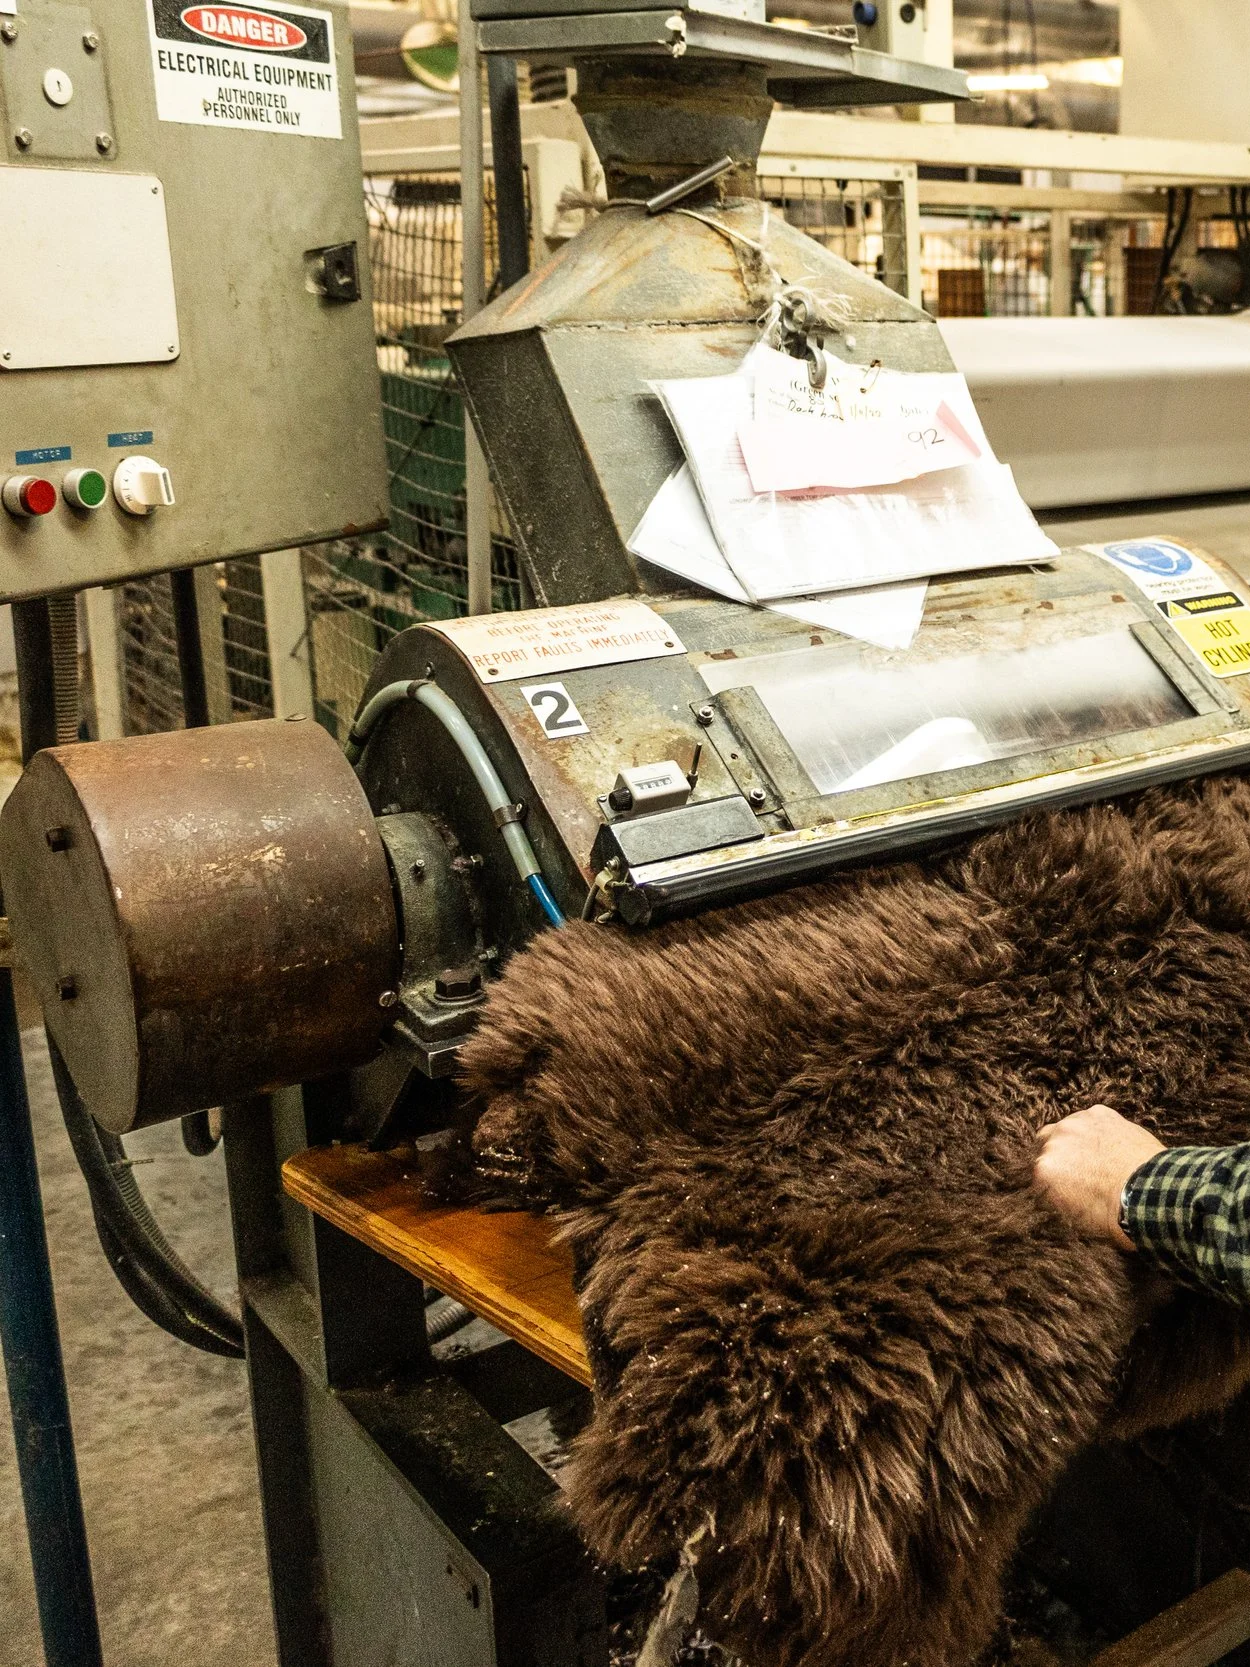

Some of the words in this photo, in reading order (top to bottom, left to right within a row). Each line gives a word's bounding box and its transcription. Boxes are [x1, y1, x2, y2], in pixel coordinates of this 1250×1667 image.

[201, 10, 289, 45] DANGER
[158, 50, 249, 80] ELECTRICAL
[254, 64, 332, 92] EQUIPMENT
[218, 87, 287, 109] AUTHORIZED
[203, 102, 272, 124] PERSONNEL
[276, 110, 300, 126] ONLY
[908, 428, 945, 449] 92
[1184, 595, 1237, 611] WARNING
[487, 623, 540, 637] BEFORE
[547, 613, 620, 629] OPERATING
[1204, 619, 1240, 639] HOT
[473, 649, 530, 668] REPORT
[535, 641, 583, 658] FAULTS
[587, 628, 670, 650] IMMEDIATELY
[531, 690, 582, 731] 2
